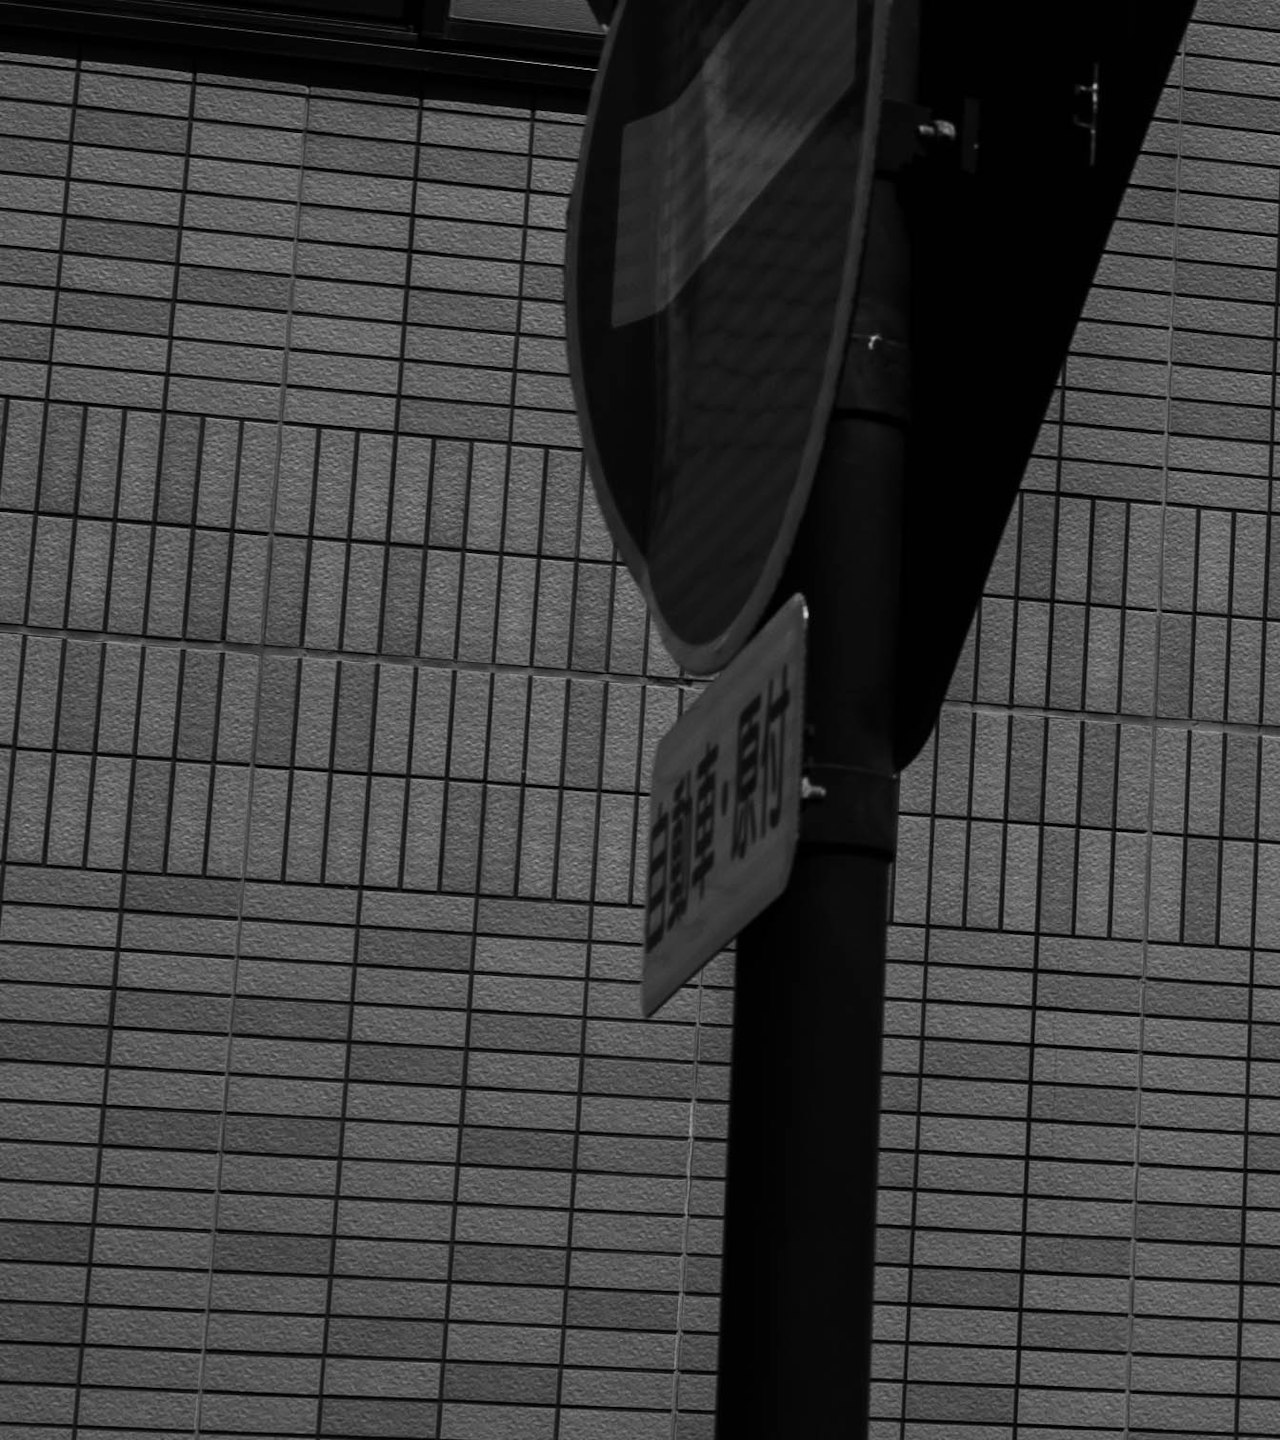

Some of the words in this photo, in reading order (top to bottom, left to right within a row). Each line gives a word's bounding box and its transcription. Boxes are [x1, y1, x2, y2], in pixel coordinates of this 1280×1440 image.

[647, 664, 790, 954] 自動車・原付
